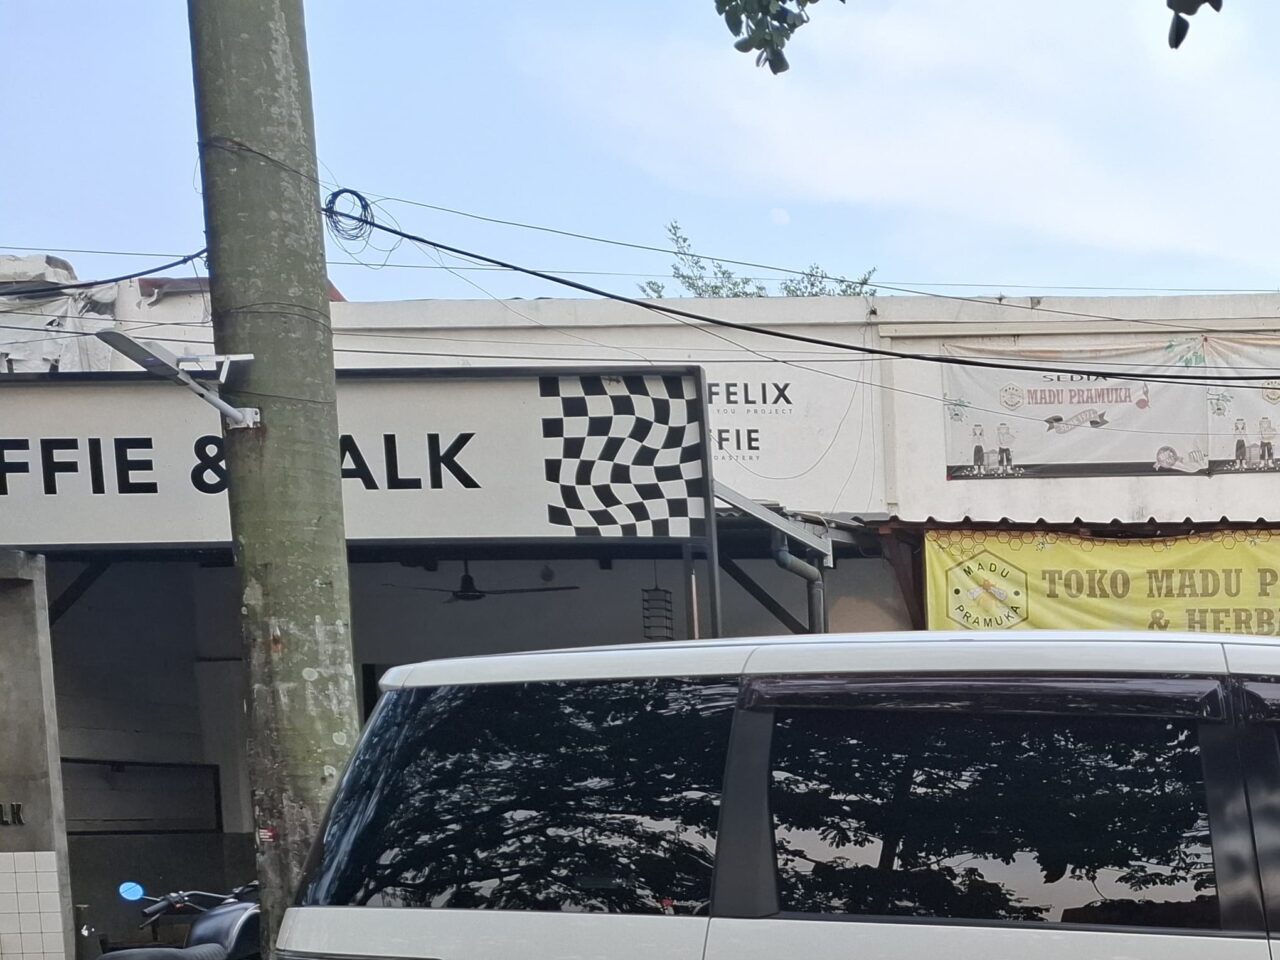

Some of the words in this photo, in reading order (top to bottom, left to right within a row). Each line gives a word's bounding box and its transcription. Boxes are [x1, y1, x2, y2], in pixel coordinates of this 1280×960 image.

[1027, 388, 1064, 405] MADU
[1068, 387, 1133, 405] PRAMUKA
[709, 428, 760, 451] FIE
[963, 561, 1011, 579] MADU
[1041, 568, 1131, 599] TOKO
[1146, 567, 1243, 599] MADU
[954, 602, 1022, 629] PRAMUKA
[1148, 608, 1170, 631] &
